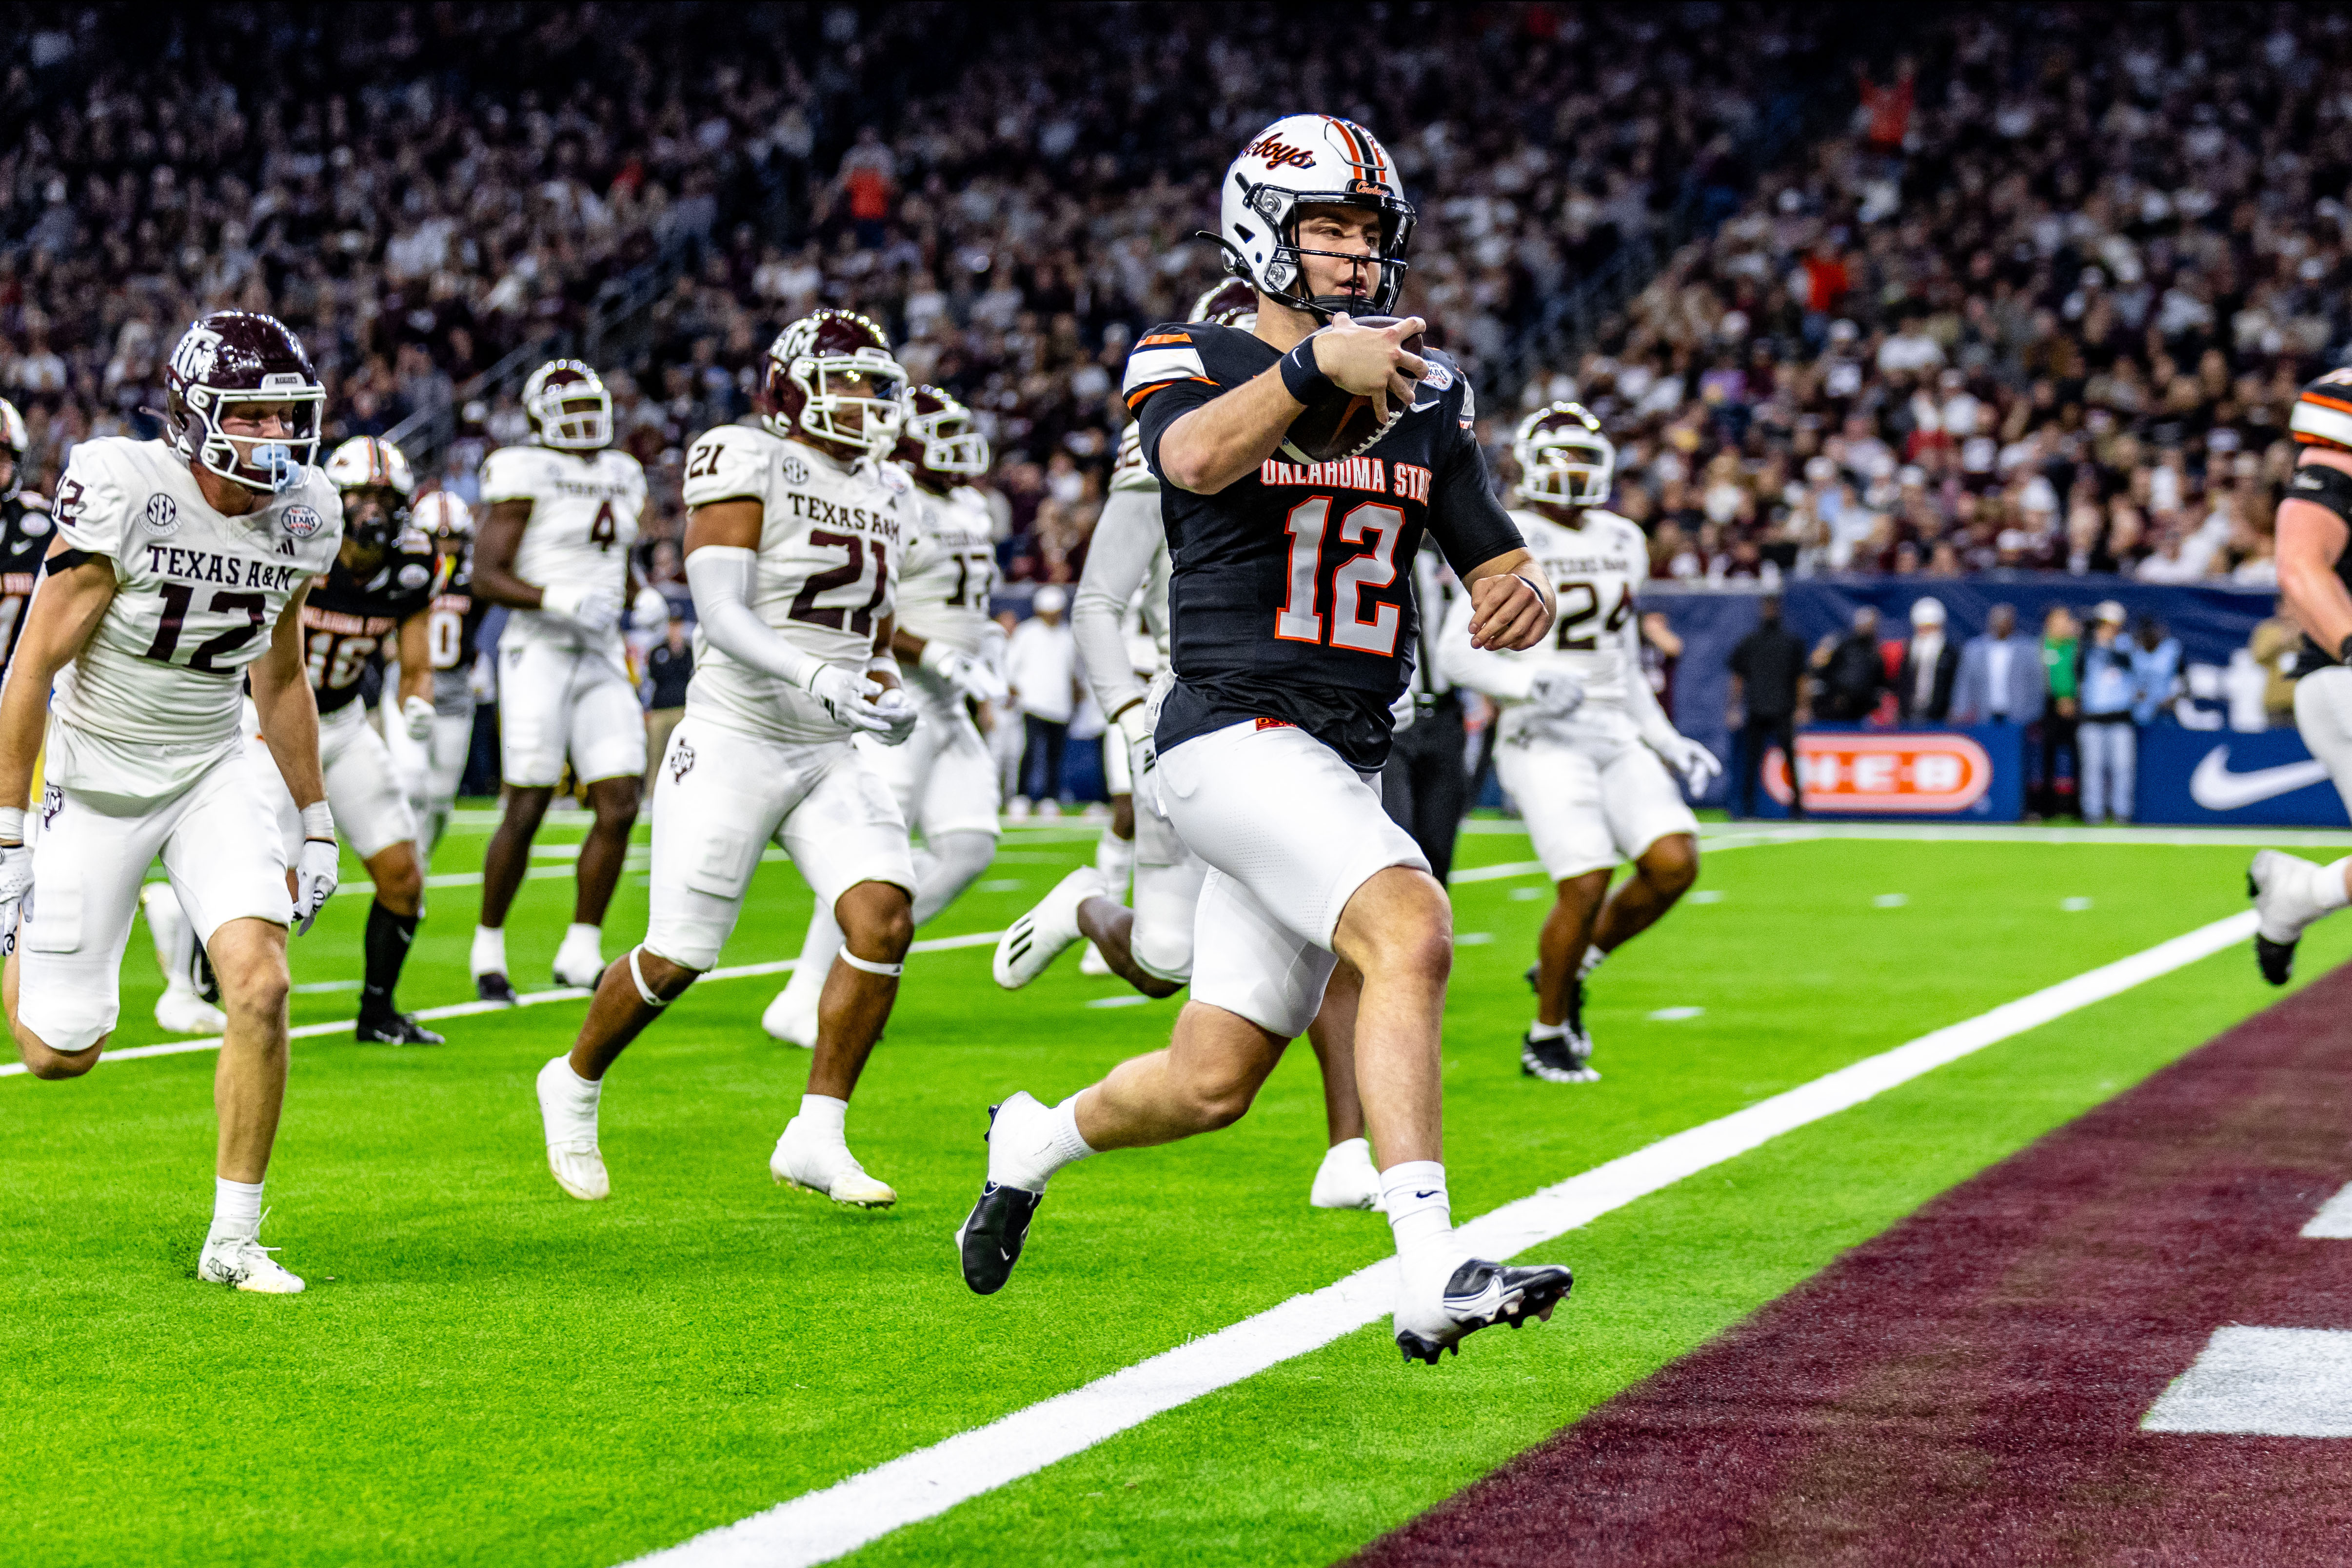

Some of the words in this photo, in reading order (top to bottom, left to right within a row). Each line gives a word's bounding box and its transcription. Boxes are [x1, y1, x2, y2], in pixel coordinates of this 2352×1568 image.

[690, 443, 725, 479] 21
[1260, 456, 1387, 494] OKLAHOMA
[147, 494, 176, 525] SEC
[287, 513, 316, 528] TEXAS
[591, 499, 616, 552] 4
[787, 491, 866, 530] TEXAS
[147, 543, 241, 585] TEXAS
[246, 560, 299, 591] A&M
[787, 528, 888, 638] 21
[1274, 495, 1405, 657] 12
[146, 581, 266, 674] 12
[1557, 580, 1634, 650] 24
